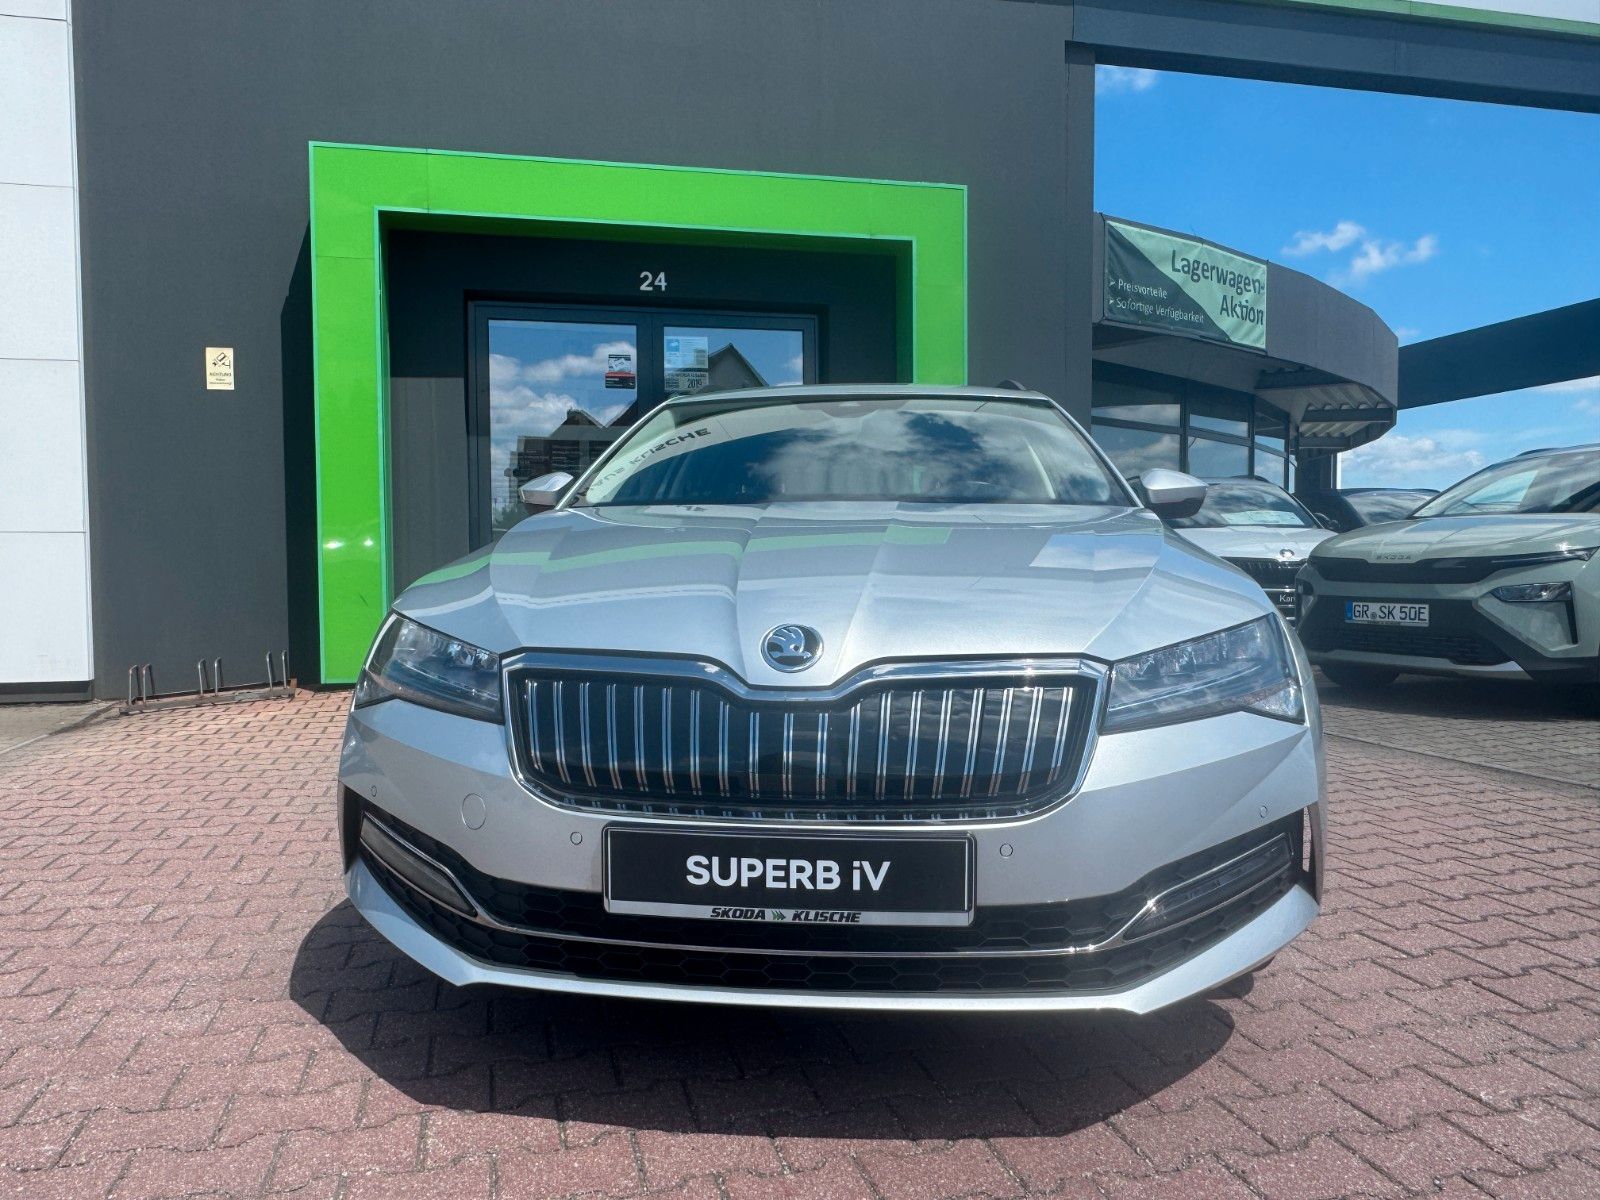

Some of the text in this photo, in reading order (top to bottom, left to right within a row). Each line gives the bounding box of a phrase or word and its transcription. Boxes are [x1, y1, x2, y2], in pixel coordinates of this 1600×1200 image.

[640, 271, 667, 291] 24
[1171, 250, 1265, 295] Lagerwagen-
[1118, 278, 1168, 299] Preisvorteile
[1116, 299, 1204, 323] Sofortige Verfügbarkeit
[1219, 295, 1264, 326] Aktion
[1353, 604, 1428, 622] GR SK 50E
[685, 855, 891, 891] SUPERB iV
[791, 910, 862, 924] KLISCHE
